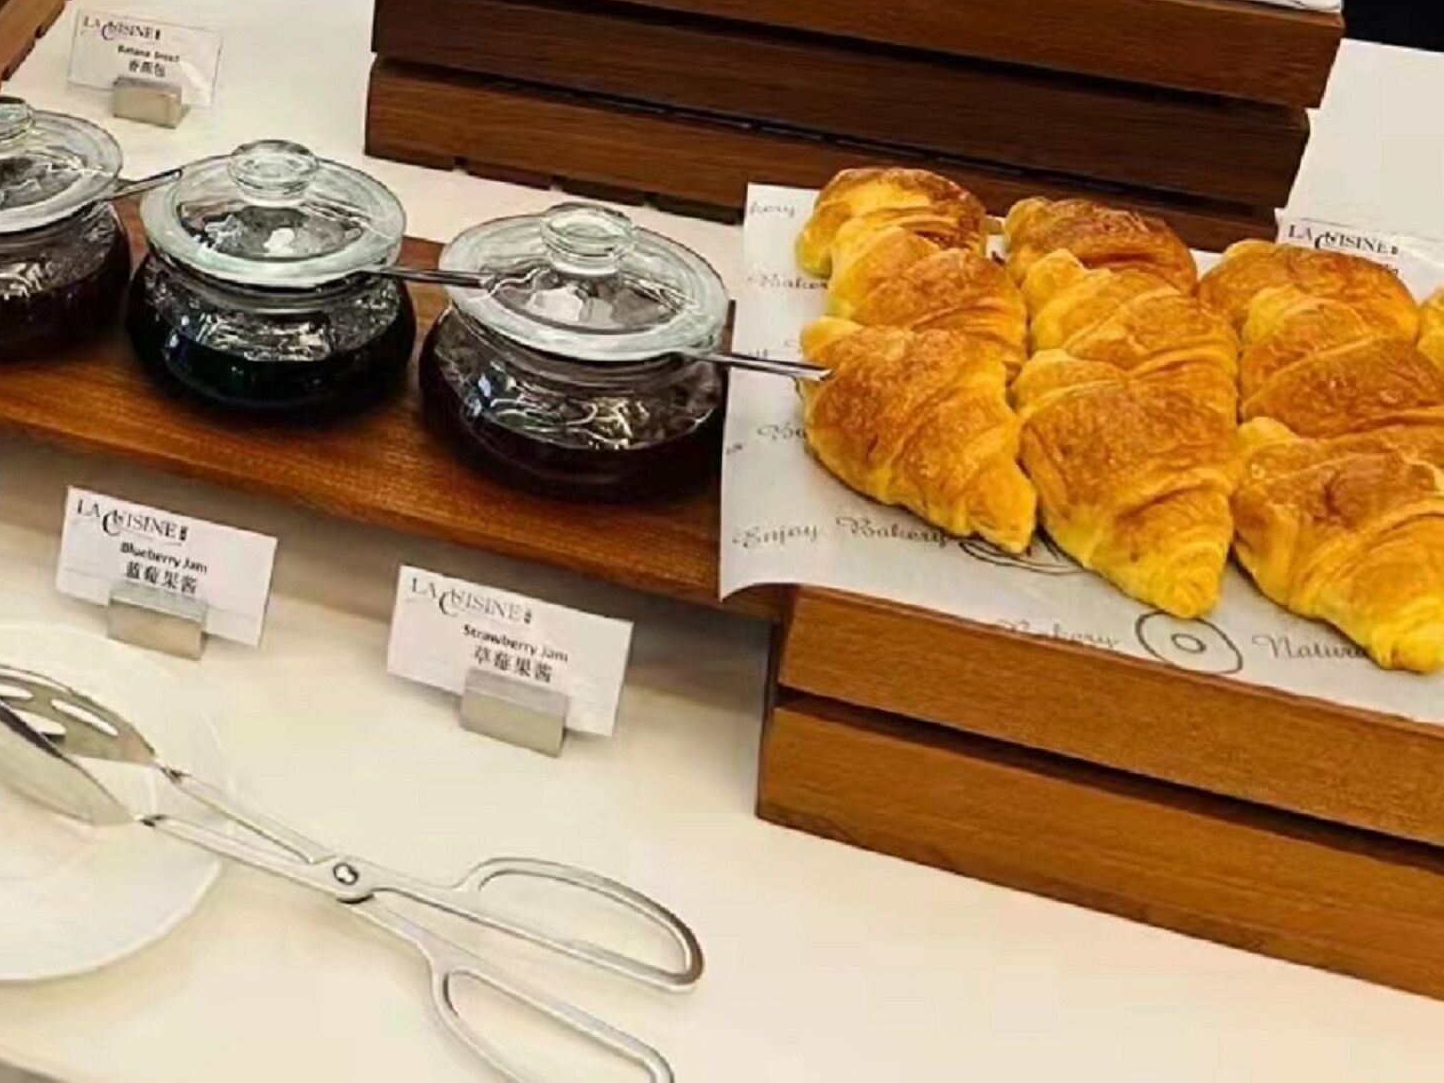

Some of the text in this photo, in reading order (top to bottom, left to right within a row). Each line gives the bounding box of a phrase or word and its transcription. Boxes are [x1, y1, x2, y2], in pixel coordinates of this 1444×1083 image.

[1288, 224, 1313, 241] LA
[76, 498, 177, 541] LA CUISINE
[120, 541, 208, 574] Blueberry Jam
[411, 577, 521, 621] LA CUISINE
[463, 623, 568, 663] Strawberry Jam
[474, 645, 552, 683] 草莓果酱
